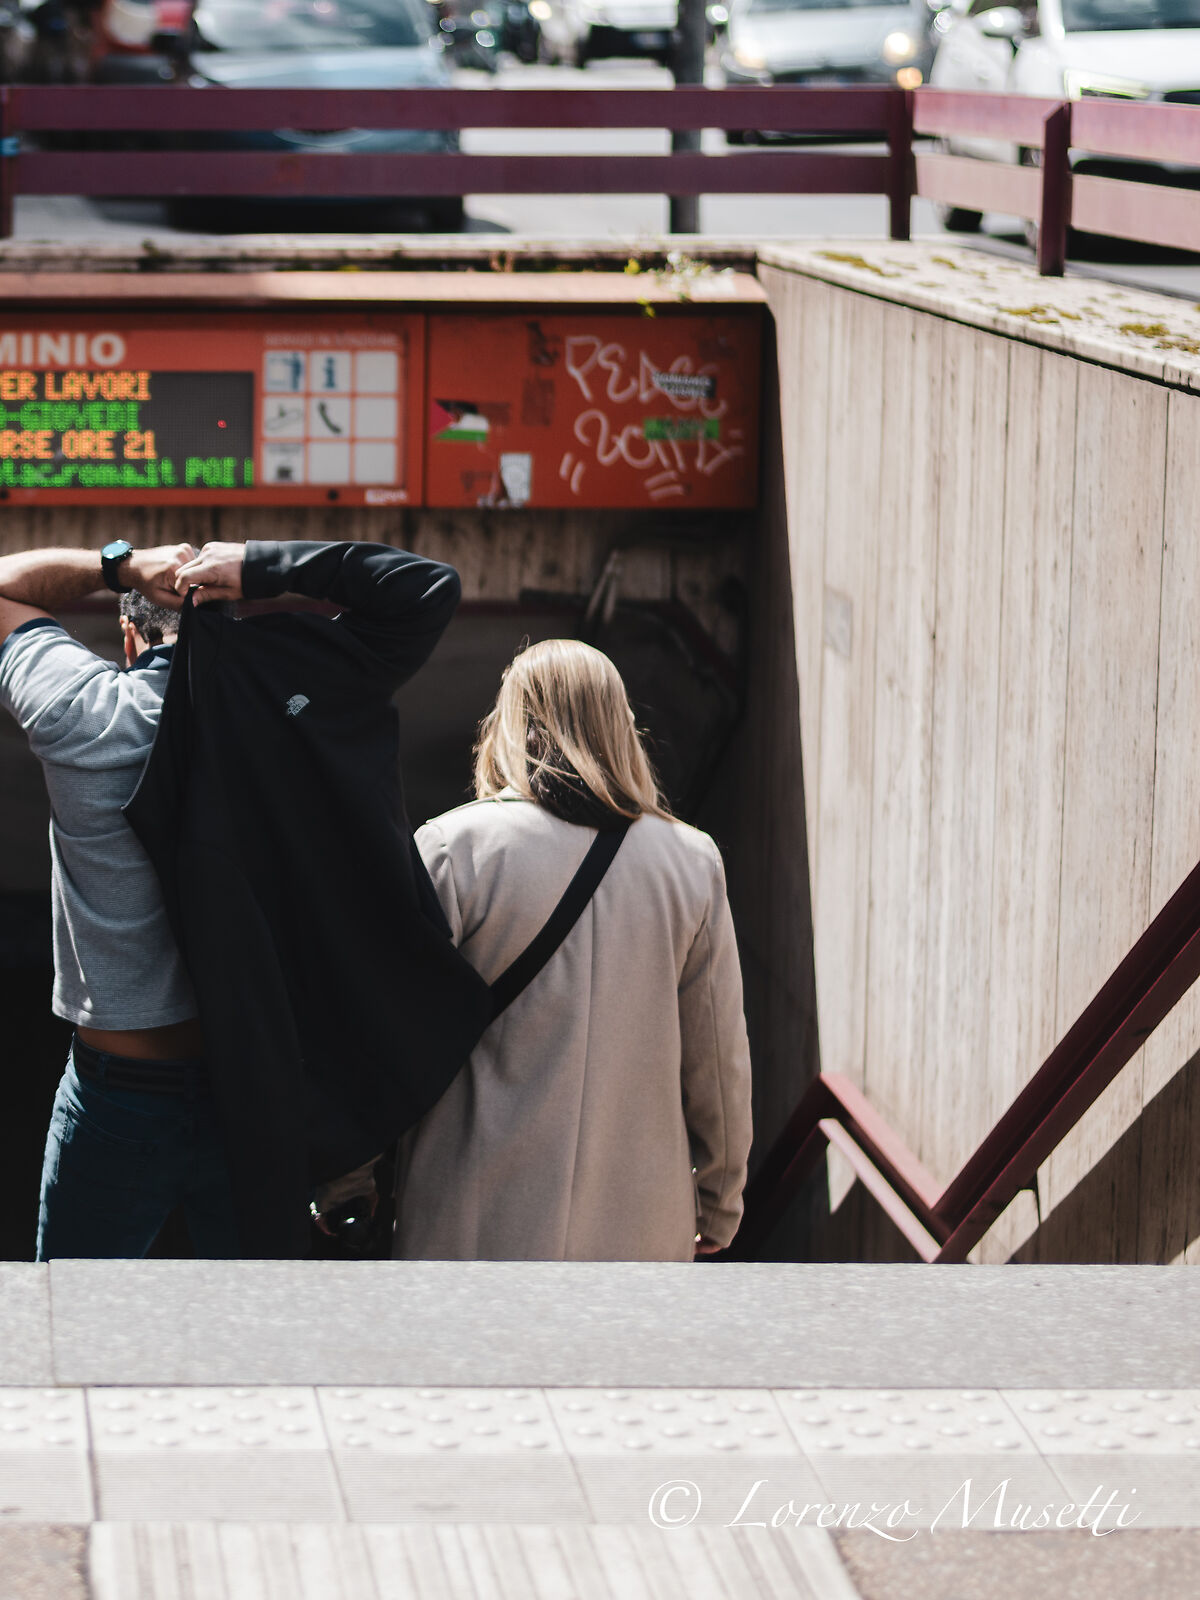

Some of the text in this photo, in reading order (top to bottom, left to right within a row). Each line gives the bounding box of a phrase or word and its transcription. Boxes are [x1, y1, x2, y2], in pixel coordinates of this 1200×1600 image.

[44, 371, 152, 400] LAVORI
[61, 430, 117, 459] ORE
[123, 430, 158, 459] 21
